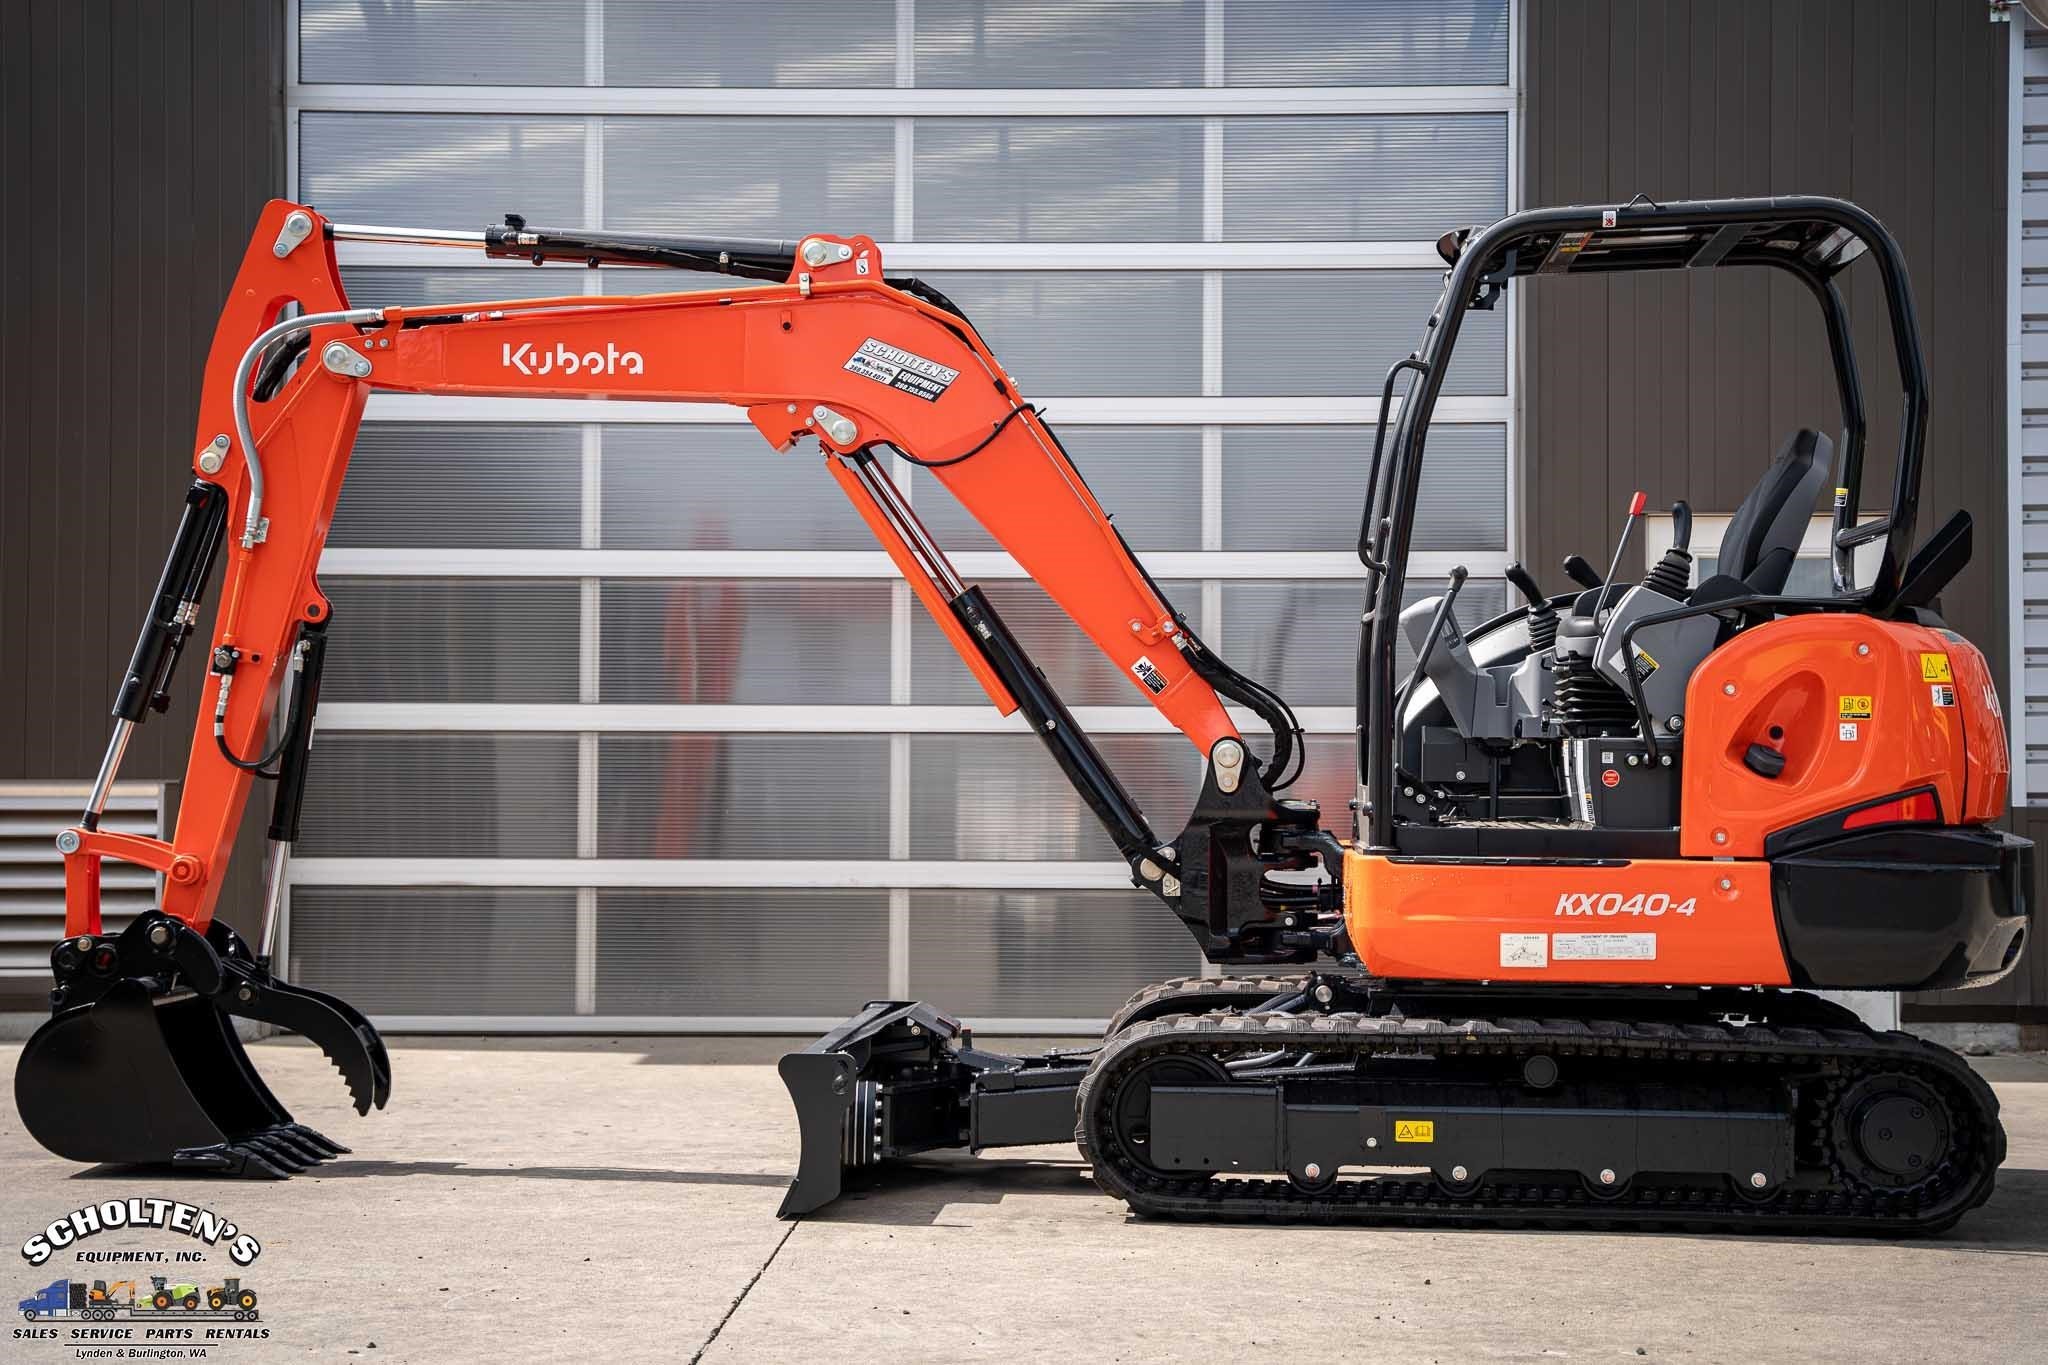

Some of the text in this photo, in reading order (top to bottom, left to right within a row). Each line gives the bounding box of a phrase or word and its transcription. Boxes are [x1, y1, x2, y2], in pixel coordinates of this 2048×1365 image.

[502, 342, 644, 376] Kubota
[862, 341, 955, 383] SCHOLTEN'S
[897, 370, 946, 394] EQUIPMENT
[1554, 893, 1697, 917] KX040-4
